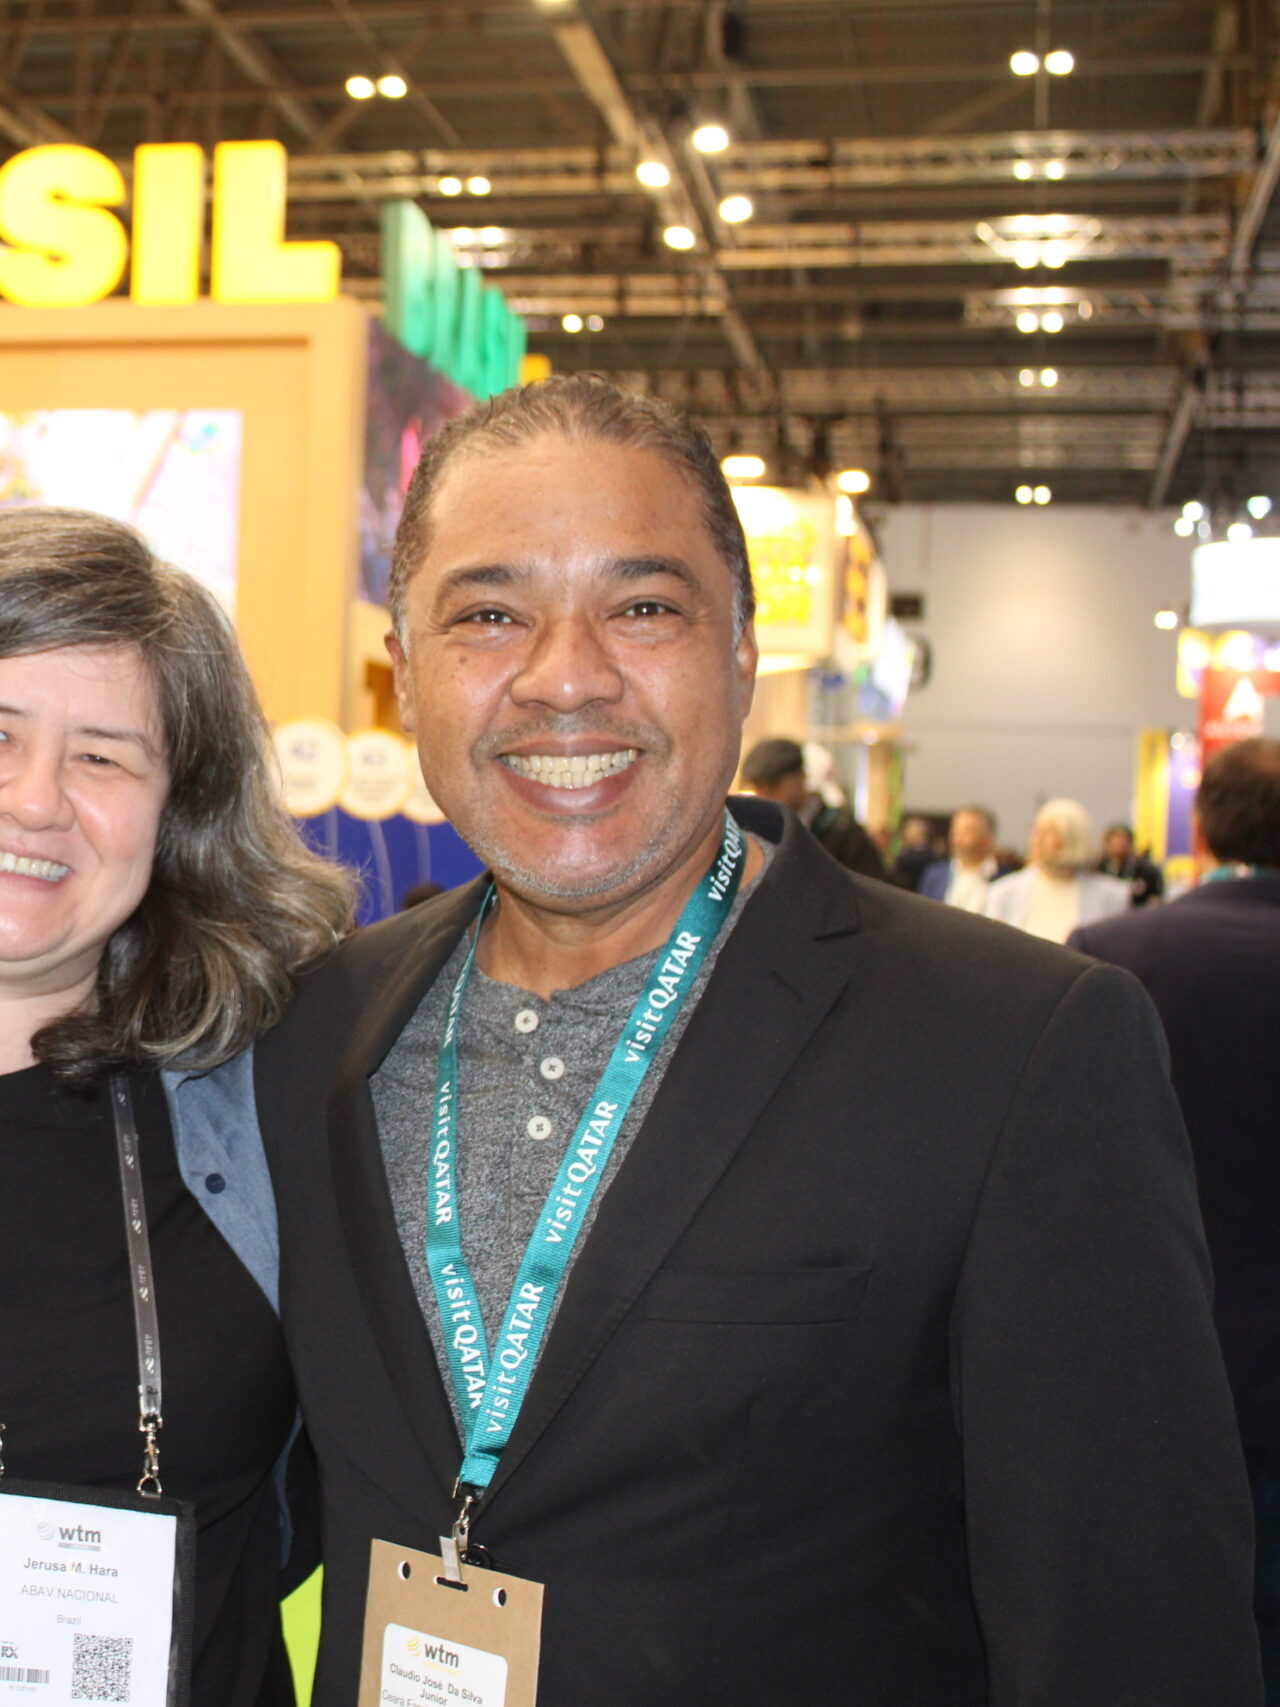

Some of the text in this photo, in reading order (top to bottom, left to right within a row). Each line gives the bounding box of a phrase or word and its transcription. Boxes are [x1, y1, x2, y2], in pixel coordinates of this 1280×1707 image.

[624, 931, 701, 1064] visitQATAR
[433, 1081, 452, 1226] visitQATAR
[545, 1100, 618, 1244] visitQATAR
[485, 1282, 545, 1432] visitQATAR
[59, 1525, 101, 1544] wtm
[23, 1558, 118, 1577] Jerusa M. Hara
[21, 1584, 119, 1604] ABAV NACIONAL
[57, 1615, 81, 1625] Brazil
[425, 1643, 459, 1668] wtm
[390, 1663, 420, 1682] Claudio
[422, 1676, 443, 1690] José
[448, 1683, 459, 1696] Da
[462, 1688, 483, 1704] Silva
[420, 1688, 447, 1705] Junior
